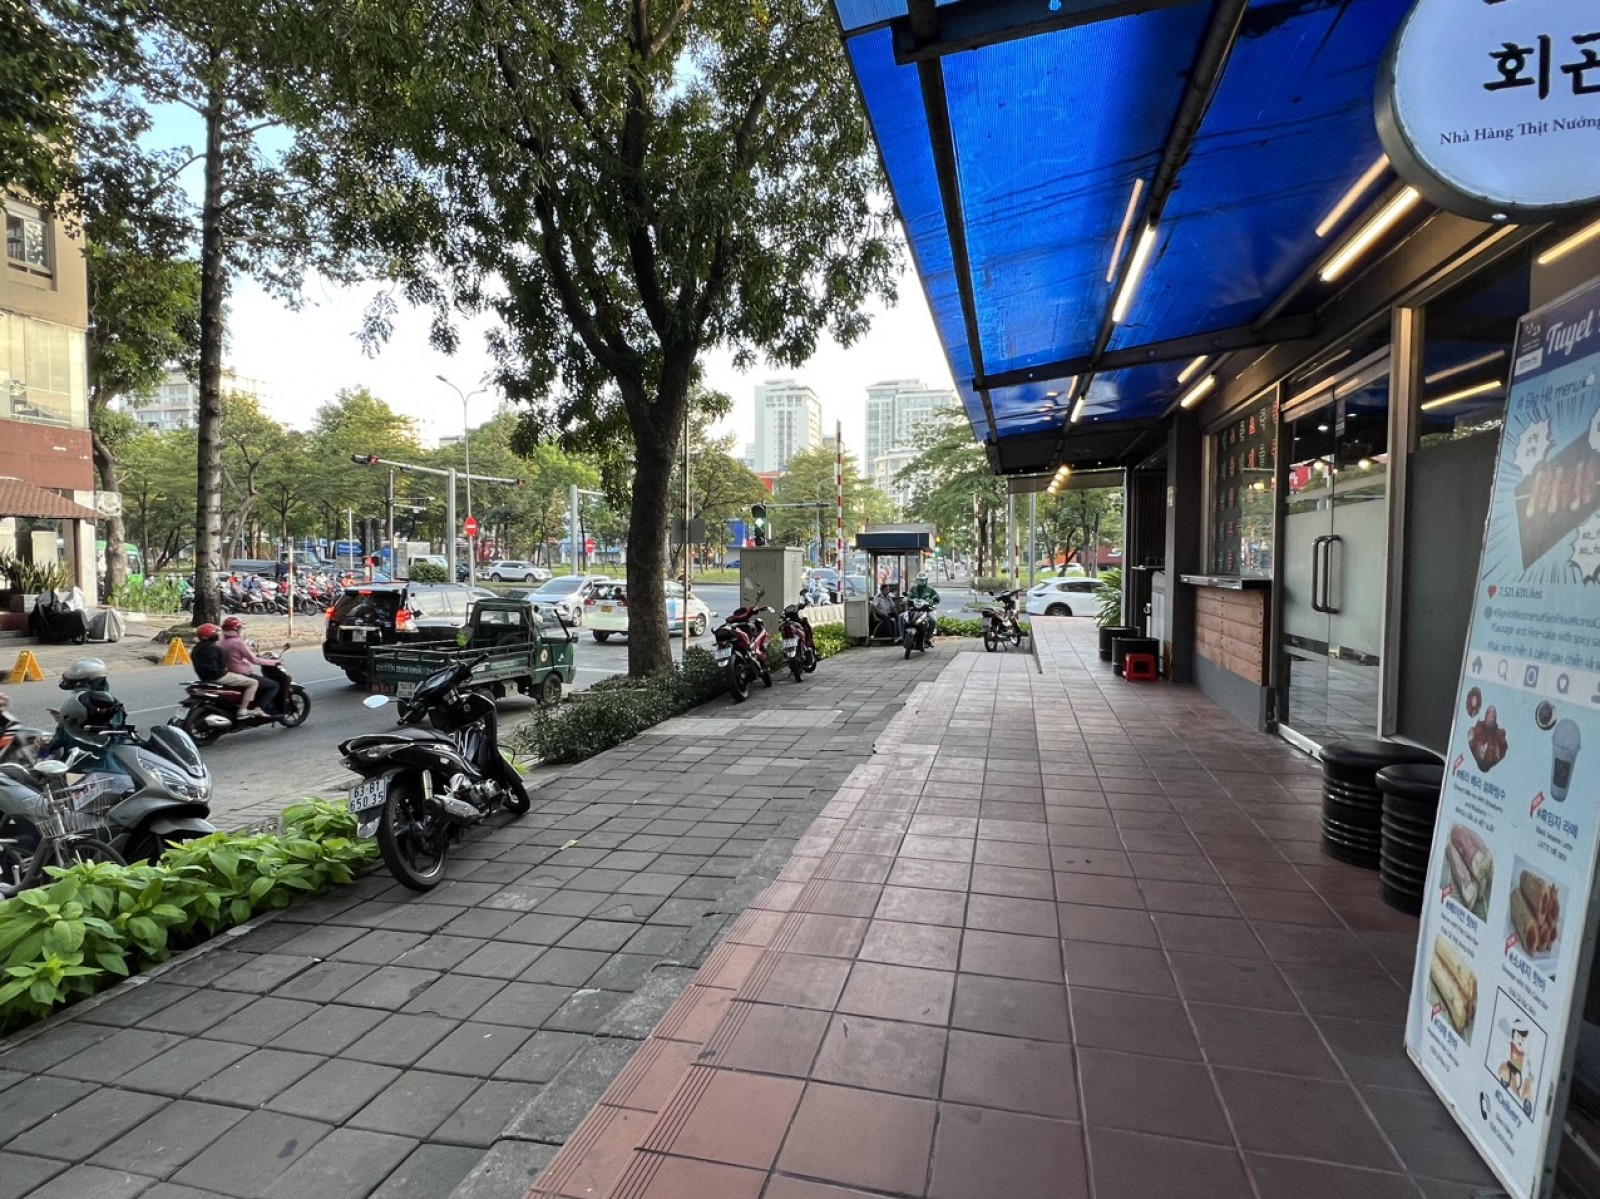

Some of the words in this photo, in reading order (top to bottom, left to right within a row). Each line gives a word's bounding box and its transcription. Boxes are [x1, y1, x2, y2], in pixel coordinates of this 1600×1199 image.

[1439, 130, 1470, 145] Nhà
[1474, 126, 1514, 142] Hàng
[1516, 121, 1548, 138] Thịt
